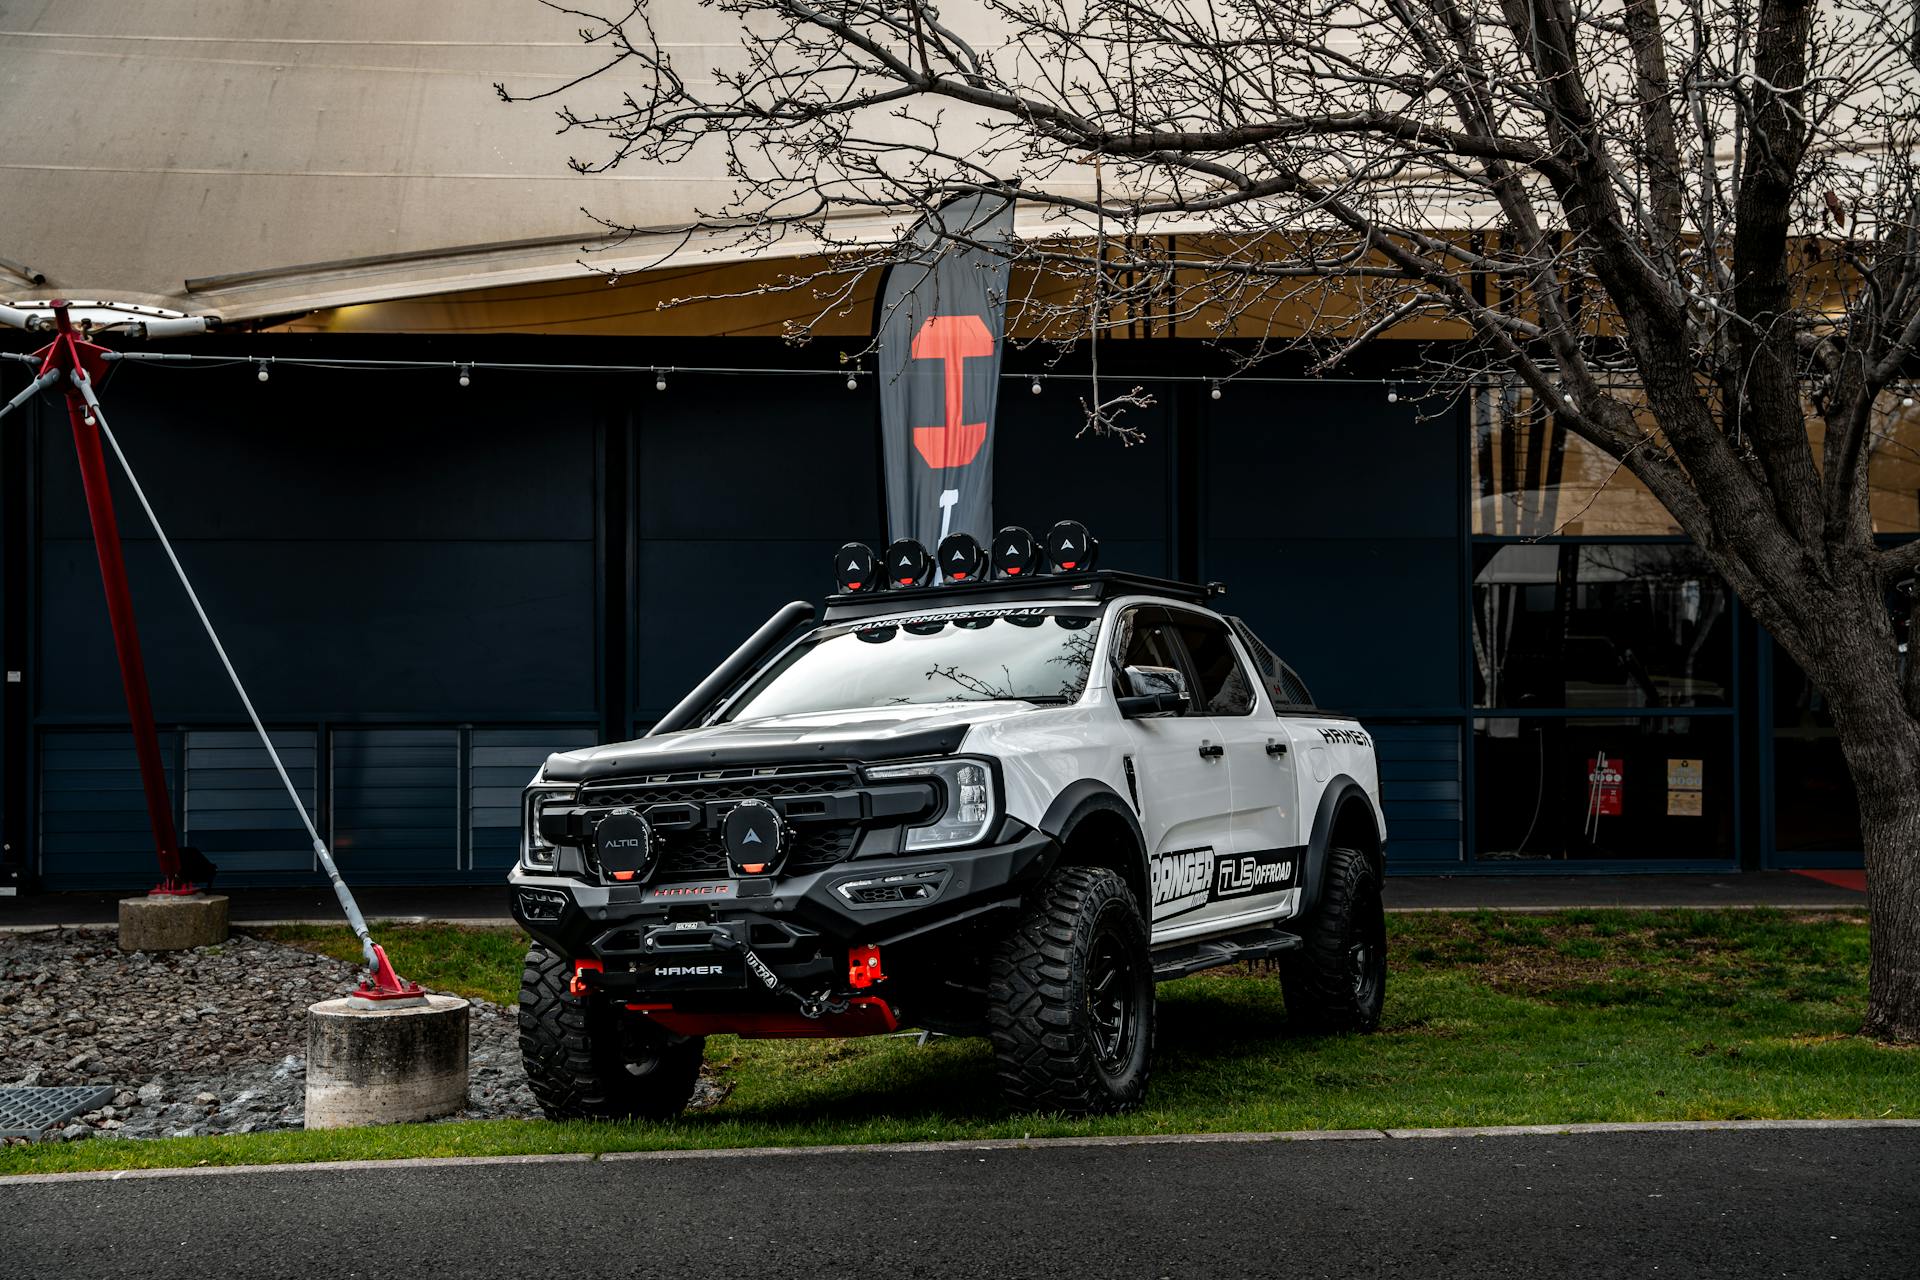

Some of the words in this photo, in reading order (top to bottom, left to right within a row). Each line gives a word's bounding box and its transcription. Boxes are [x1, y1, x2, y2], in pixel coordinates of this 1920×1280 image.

[849, 608, 1046, 632] RANGERMODS.COM.AU
[1317, 728, 1371, 748] HAMER
[605, 839, 638, 848] ALTIQ
[1150, 850, 1214, 904] RANGER
[1255, 861, 1291, 885] OFFROAD
[655, 886, 728, 896] HAMER
[655, 966, 723, 976] HAMER
[747, 956, 775, 986] ULTRA
